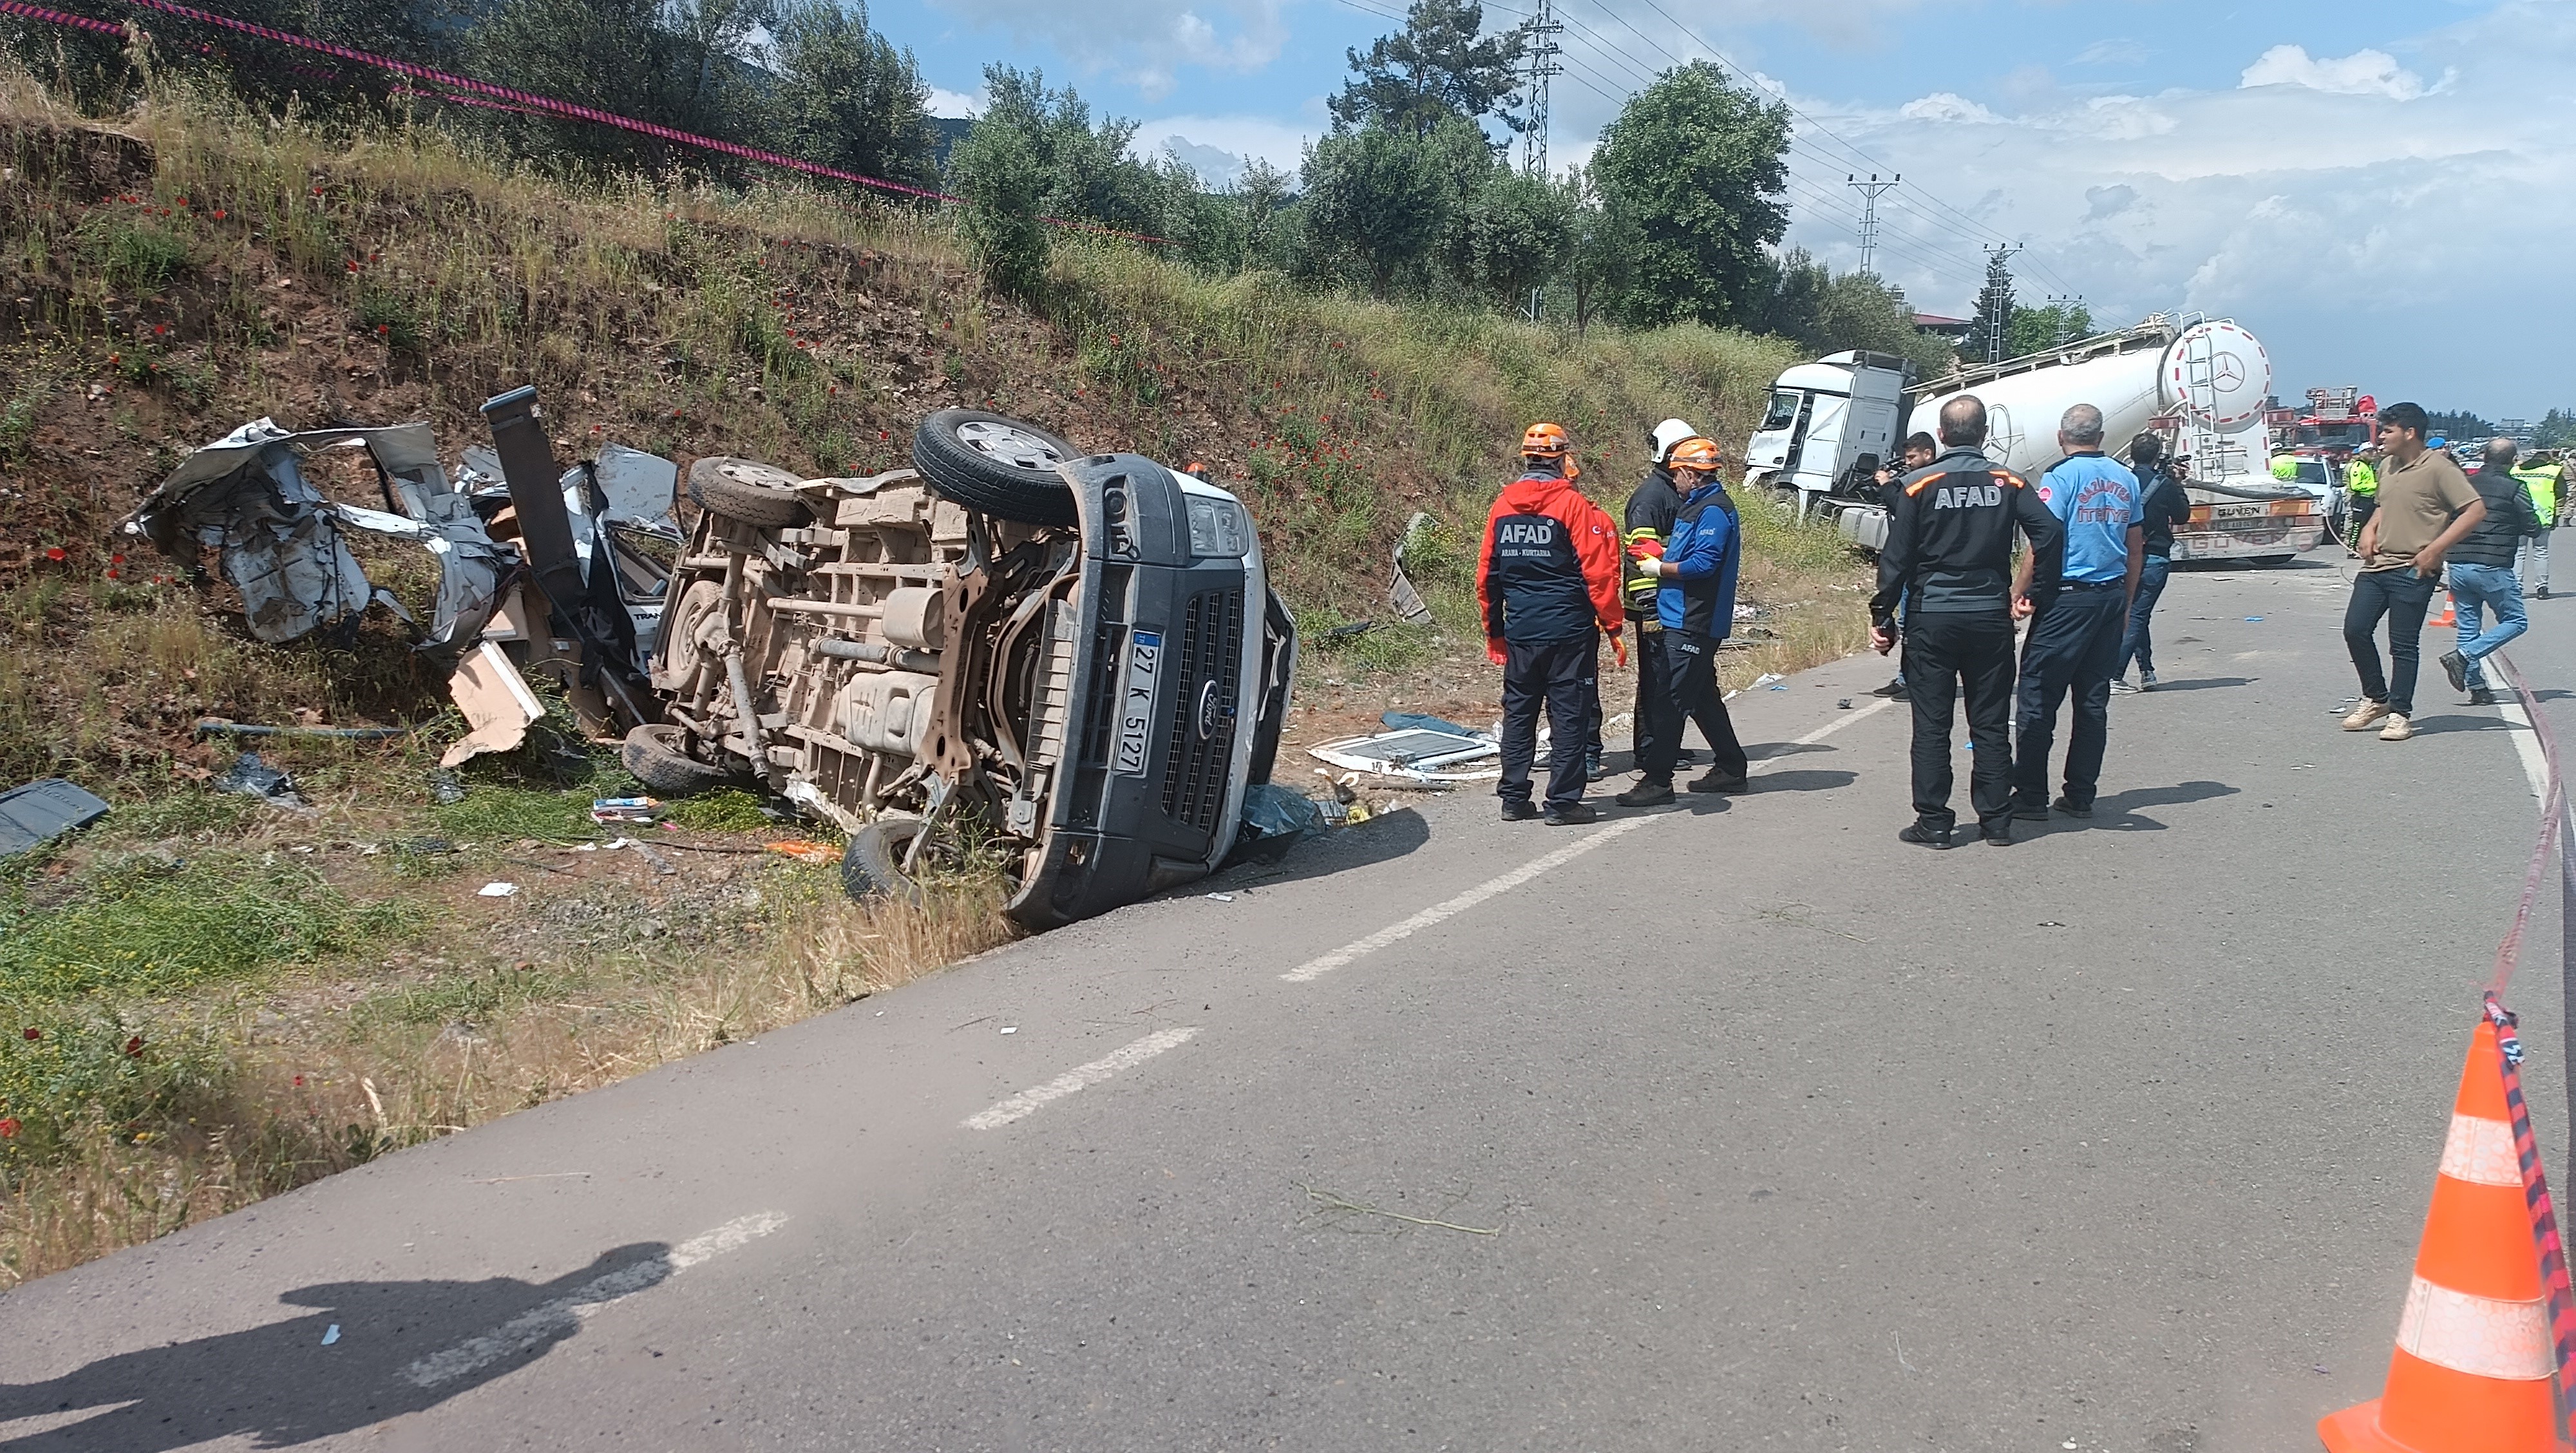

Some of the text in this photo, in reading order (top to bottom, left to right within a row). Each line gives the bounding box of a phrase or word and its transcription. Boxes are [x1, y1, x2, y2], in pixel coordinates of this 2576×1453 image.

[1934, 486, 2002, 509] AFAD
[1500, 524, 1552, 544] AFAD
[1139, 634, 1145, 643] TR
[1681, 643, 1700, 654] AFAD
[1120, 647, 1155, 768] 27 K 5127
[1204, 693, 1217, 726] Ford
